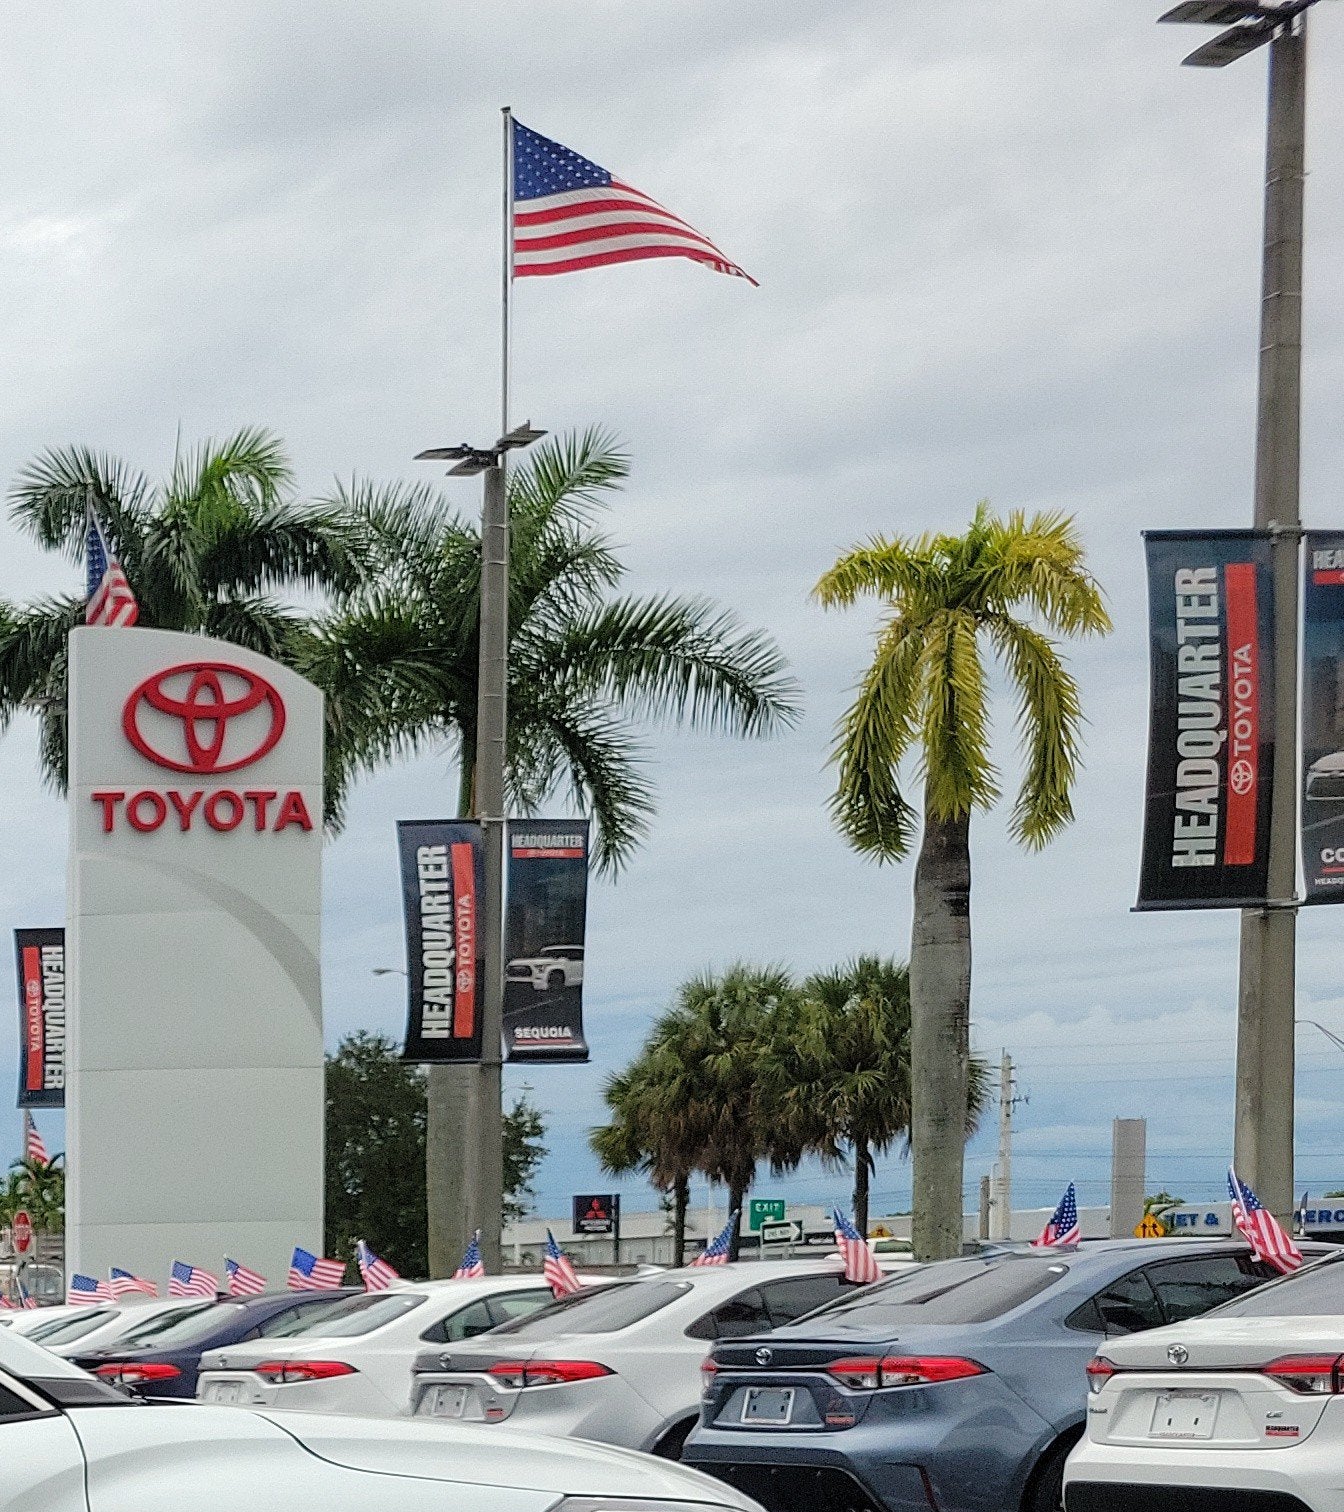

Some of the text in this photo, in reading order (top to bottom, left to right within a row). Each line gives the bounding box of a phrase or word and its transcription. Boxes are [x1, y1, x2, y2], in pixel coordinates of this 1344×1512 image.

[1172, 566, 1228, 867] HEADQUARTER
[1233, 643, 1252, 757] TOYOTA
[91, 790, 313, 833] TOYOTA
[417, 844, 455, 1039] HEADQUARTER
[458, 894, 474, 966] TOYOTA
[41, 945, 65, 1090] HEADQUARTER
[514, 1026, 572, 1039] SEQUOIA
[755, 1202, 779, 1212] EXIT
